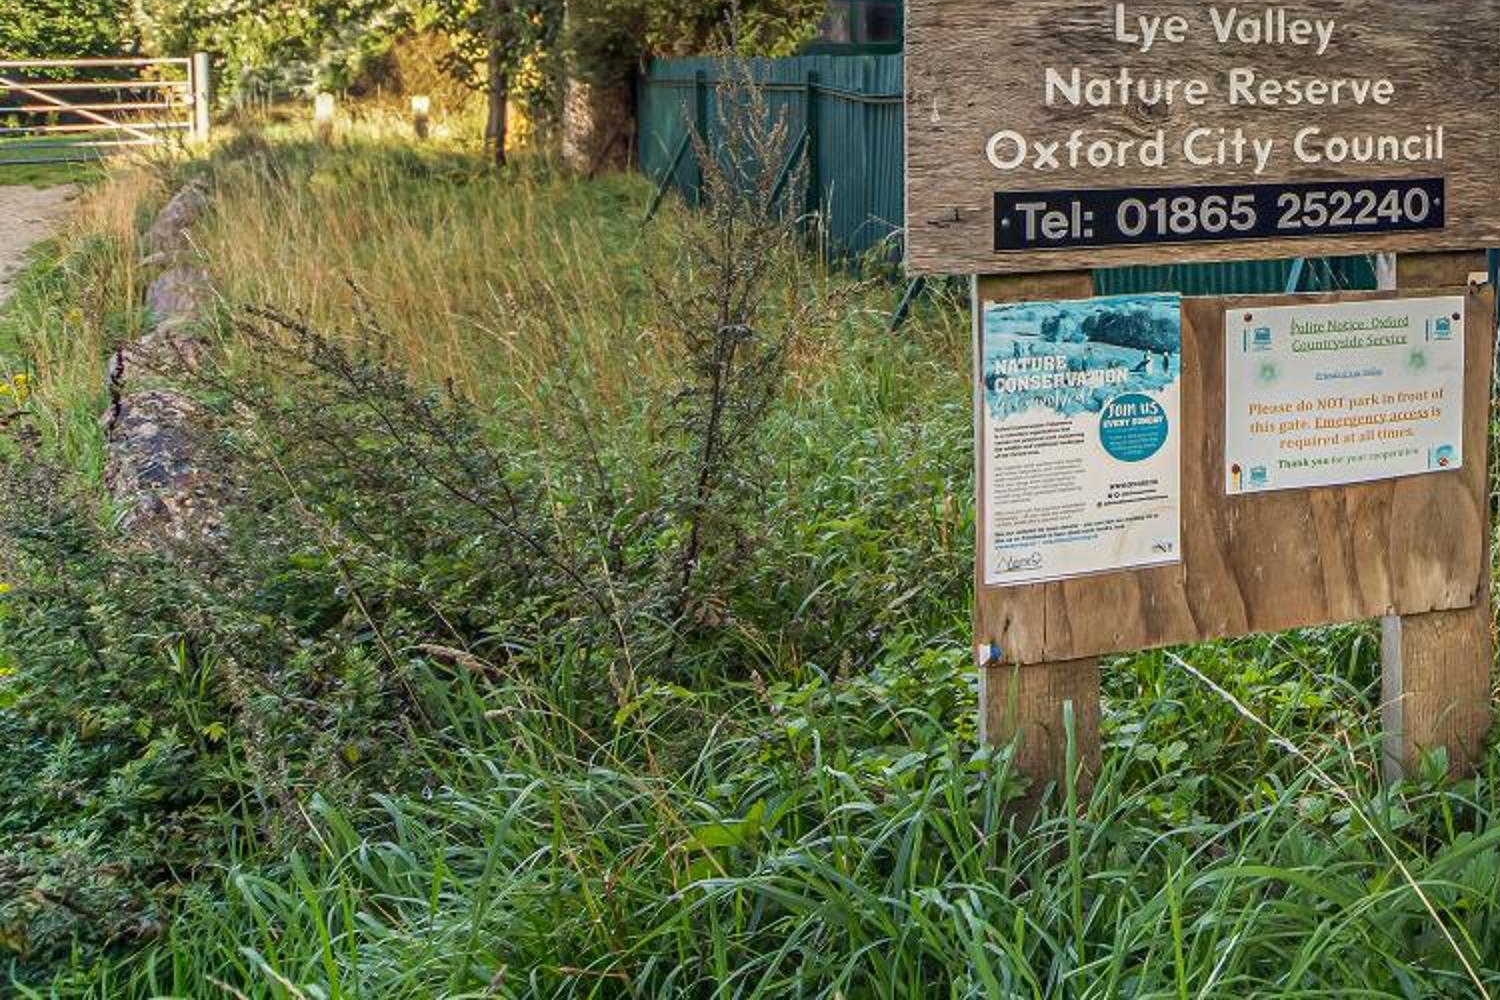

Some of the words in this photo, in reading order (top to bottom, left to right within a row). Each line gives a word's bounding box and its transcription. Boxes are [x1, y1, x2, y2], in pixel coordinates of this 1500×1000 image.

[1115, 3, 1189, 52] Lye
[1209, 7, 1336, 56] Valley
[1045, 66, 1209, 108] Nature
[1229, 67, 1395, 106] Reserve
[986, 129, 1165, 171] Oxford
[1184, 127, 1274, 174] City
[1294, 126, 1444, 164] Council
[1015, 202, 1094, 241] Tel:
[1117, 194, 1256, 238] 01865
[1276, 187, 1430, 230] 252240
[1292, 336, 1363, 353] Countryside
[1367, 334, 1409, 347] Service
[994, 355, 1067, 375] NATURE
[994, 368, 1129, 394] CONSERVATION
[1107, 402, 1137, 419] JOIN
[1140, 401, 1160, 415] US
[1249, 402, 1293, 417] Please
[1296, 399, 1313, 412] do
[1317, 397, 1345, 410] NOT
[1349, 394, 1380, 411] park
[1382, 392, 1395, 405] in
[1397, 390, 1428, 403] front
[1431, 388, 1445, 400] of
[1250, 420, 1275, 433] this
[1315, 411, 1386, 430] Emergency
[1388, 410, 1429, 423] access
[1430, 407, 1442, 419] is
[1280, 432, 1340, 451] required
[1343, 430, 1356, 443] at
[1358, 428, 1375, 441] all
[1279, 458, 1309, 469] Thank
[1311, 457, 1329, 469] you
